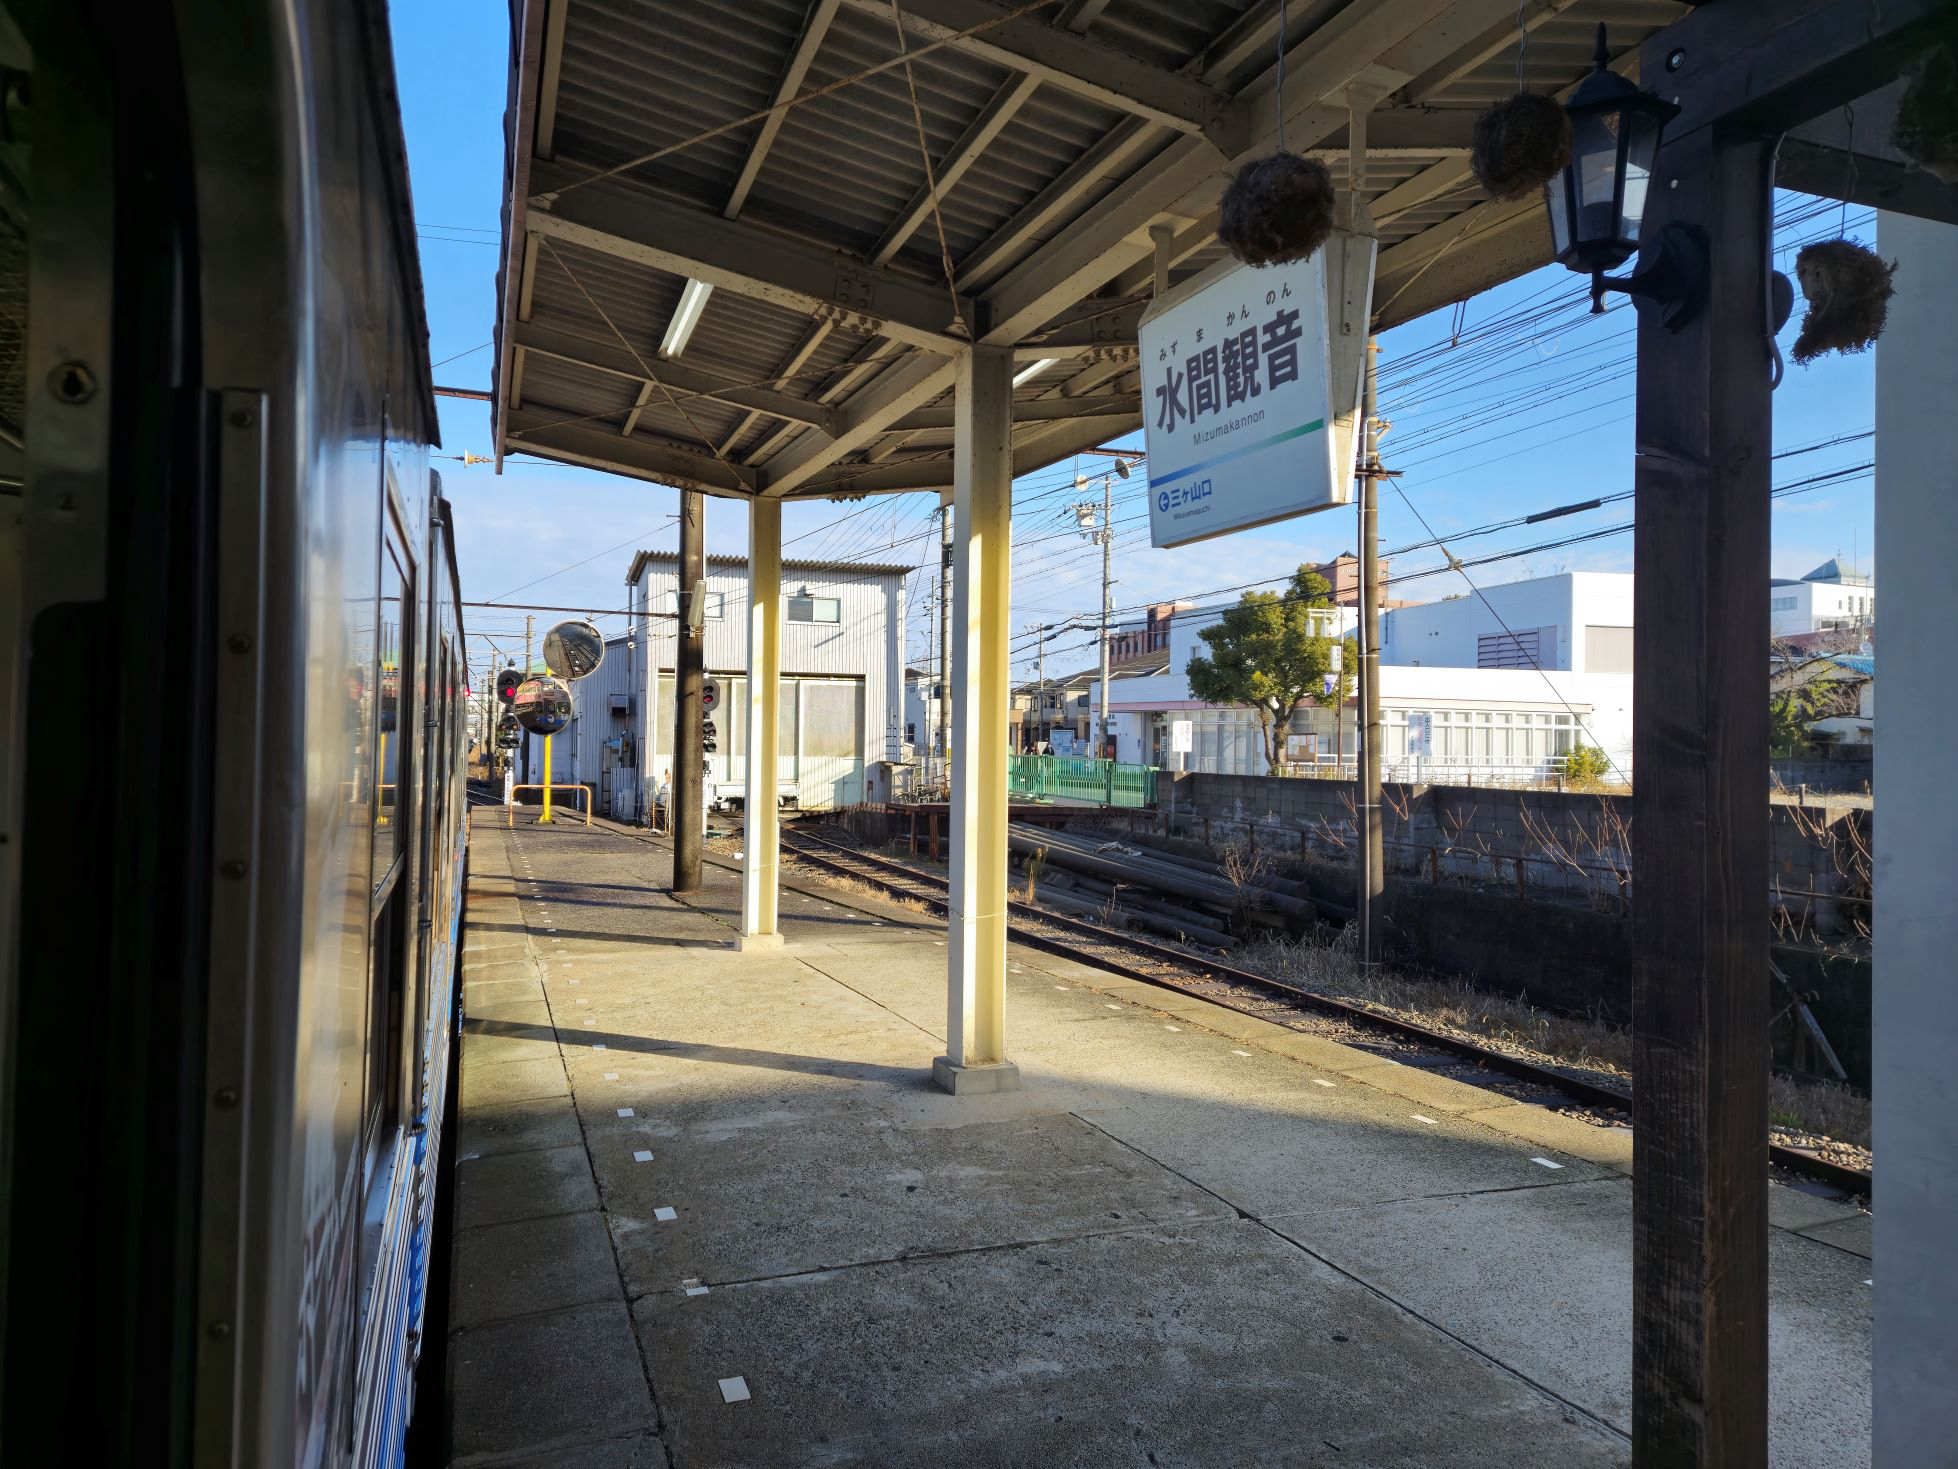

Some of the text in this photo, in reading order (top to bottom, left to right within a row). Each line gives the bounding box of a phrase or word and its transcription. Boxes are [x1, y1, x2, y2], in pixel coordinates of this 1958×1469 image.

[1155, 308, 1303, 434] 水間観音
[1193, 408, 1265, 446] Mizumakannon
